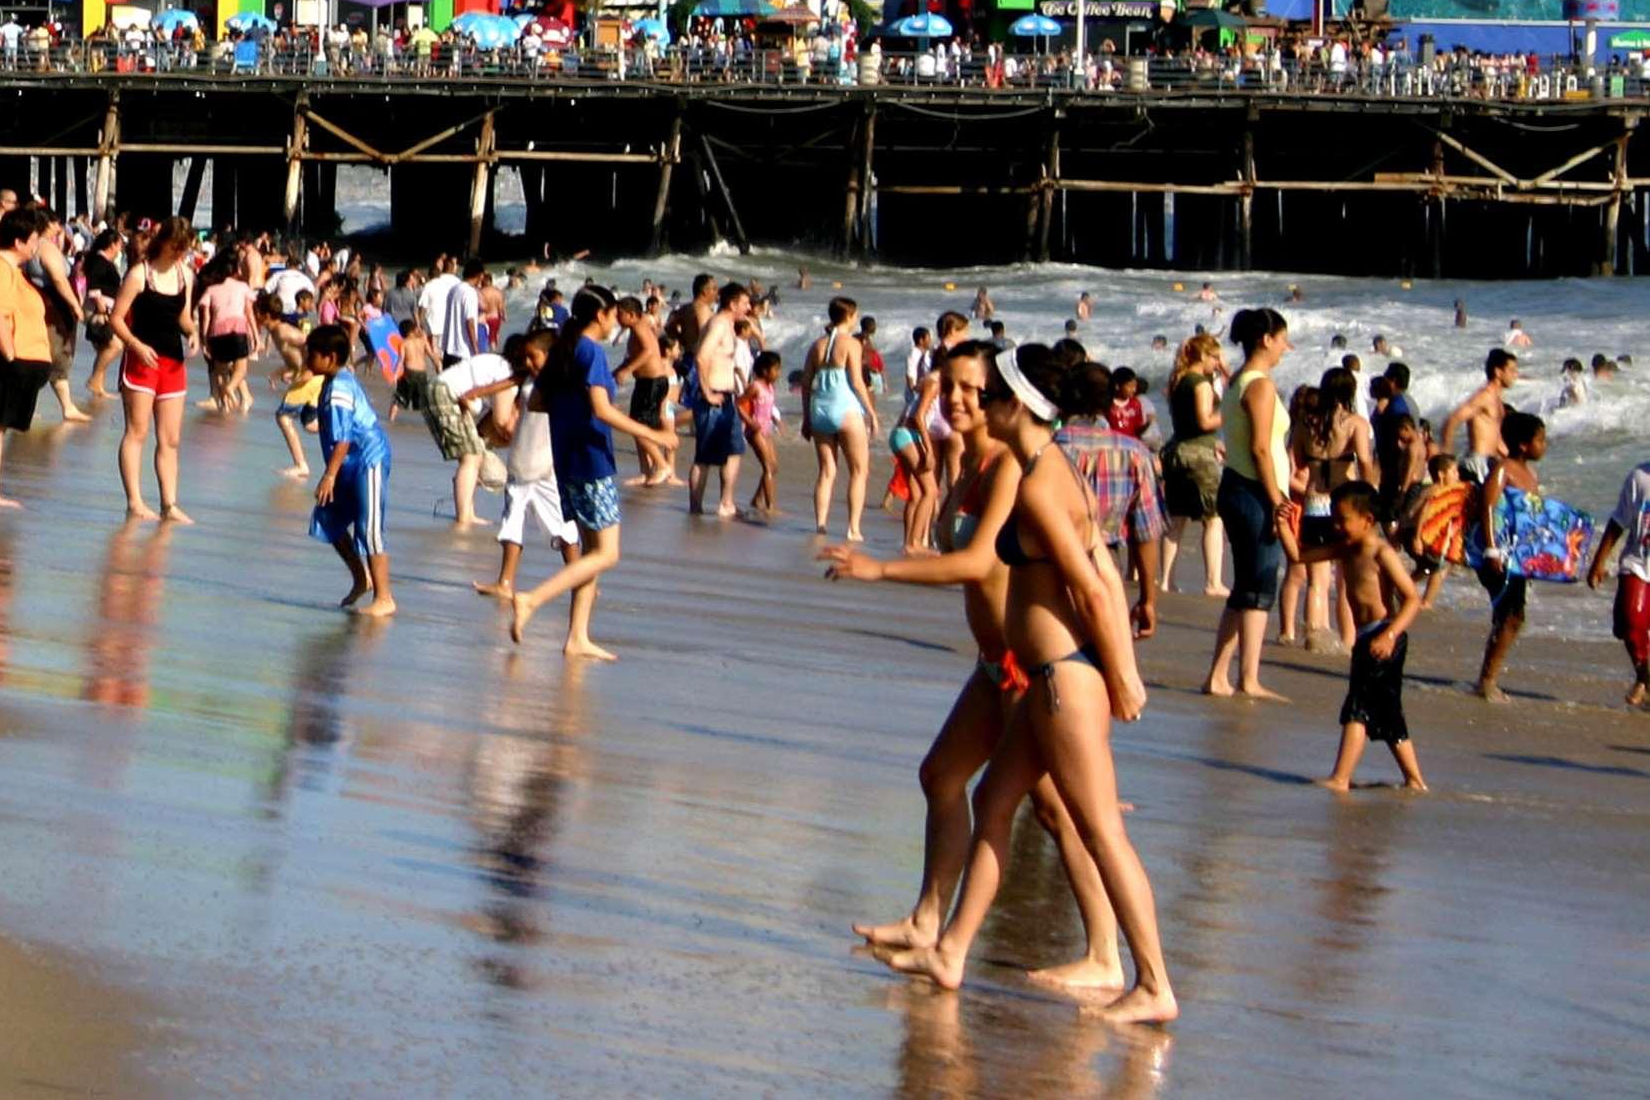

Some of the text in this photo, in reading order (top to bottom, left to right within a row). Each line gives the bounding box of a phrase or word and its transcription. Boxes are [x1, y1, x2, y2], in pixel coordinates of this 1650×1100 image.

[1040, 1, 1153, 18] The Cffee Bean
